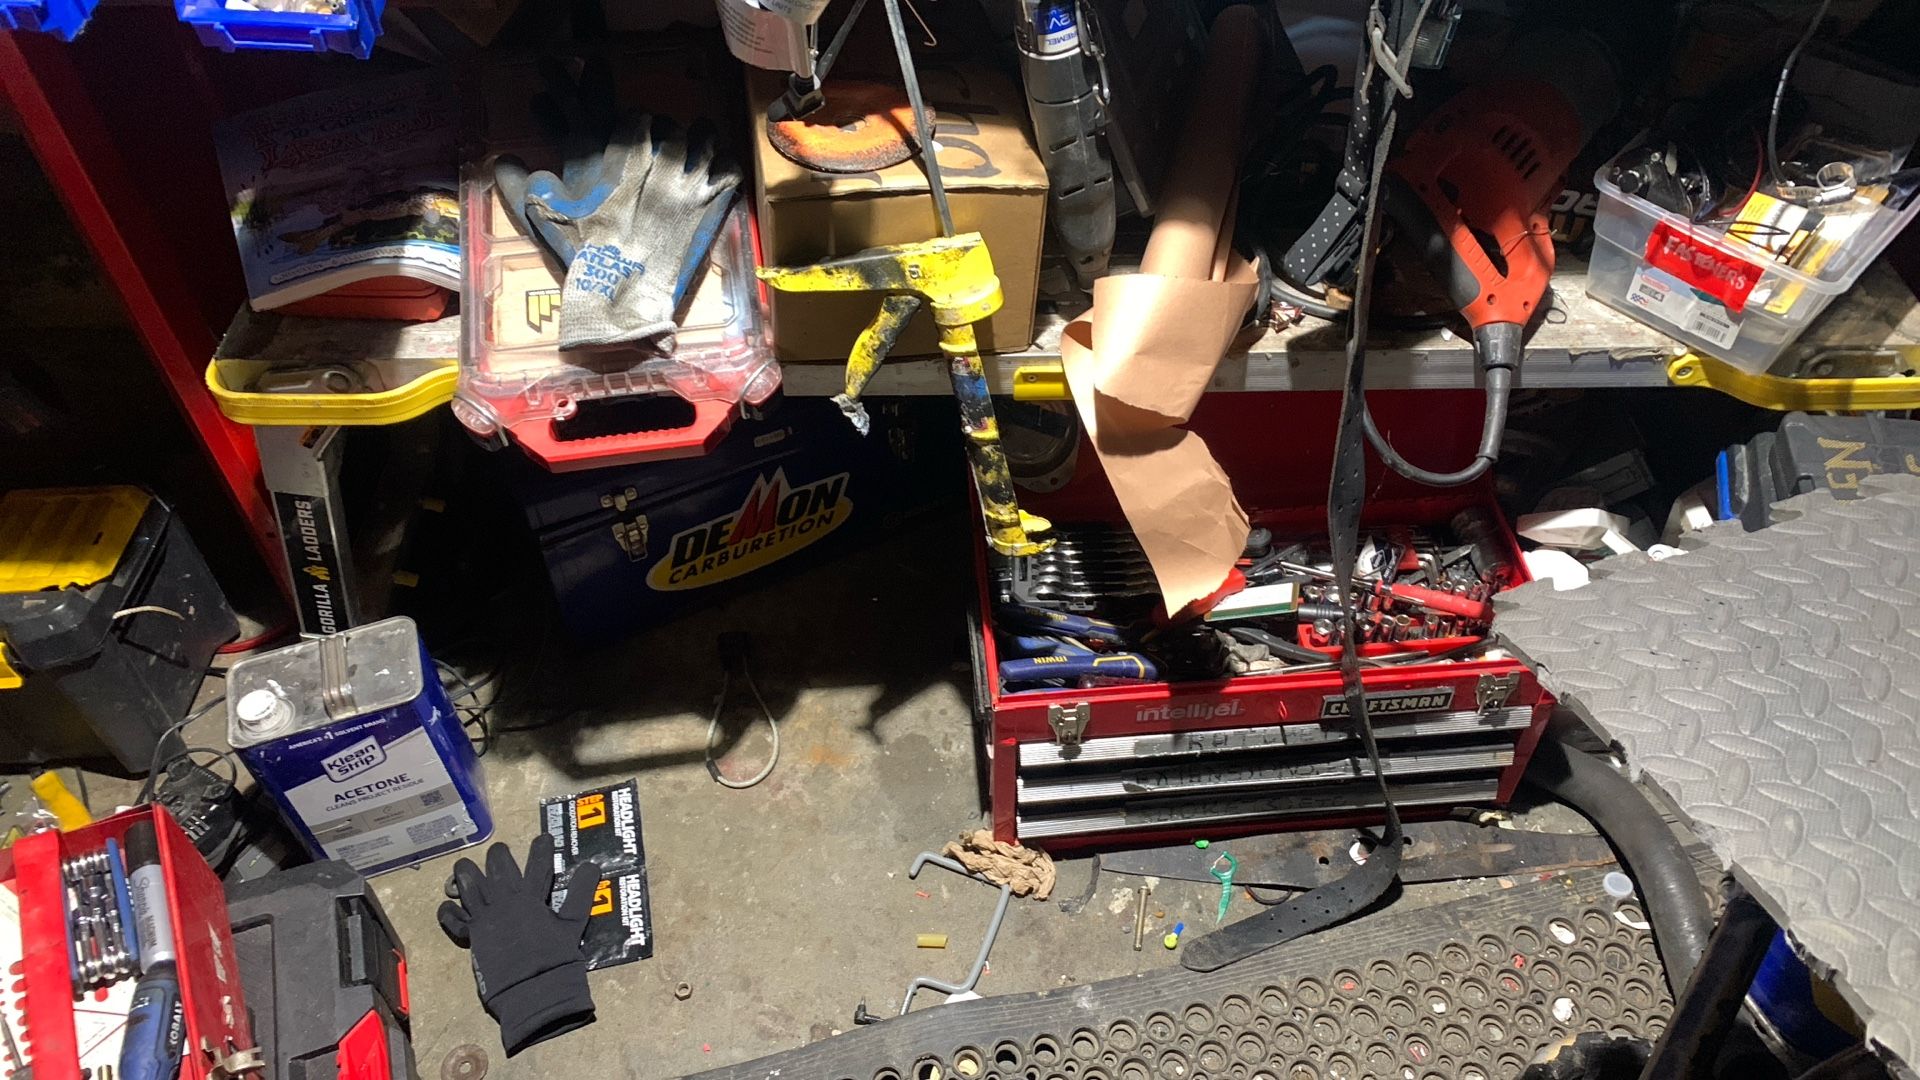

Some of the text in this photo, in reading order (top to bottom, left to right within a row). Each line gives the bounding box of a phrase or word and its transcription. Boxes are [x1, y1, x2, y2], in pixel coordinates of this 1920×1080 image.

[1045, 31, 1078, 46] REMEL
[576, 251, 632, 279] ATLAS
[583, 264, 619, 285] 300
[1664, 235, 1747, 290] FASTENERS
[671, 477, 845, 570] DEMON
[668, 510, 834, 584] CARBURETION
[295, 500, 337, 635] GORILLA LADDERS
[1033, 655, 1067, 665] IRWIN
[1330, 695, 1445, 714] CRFTSMAN
[334, 724, 364, 737] SOLVENT
[327, 744, 376, 770] Klean
[337, 754, 375, 776] Strip
[326, 778, 424, 813] CLEANS PROJECT RESIDUE
[334, 773, 411, 803] ACETONE
[579, 806, 602, 821] 1
[617, 787, 638, 855] HEADLIGHT
[619, 876, 628, 915] RESTORATION
[625, 874, 647, 946] HEADLIGHT
